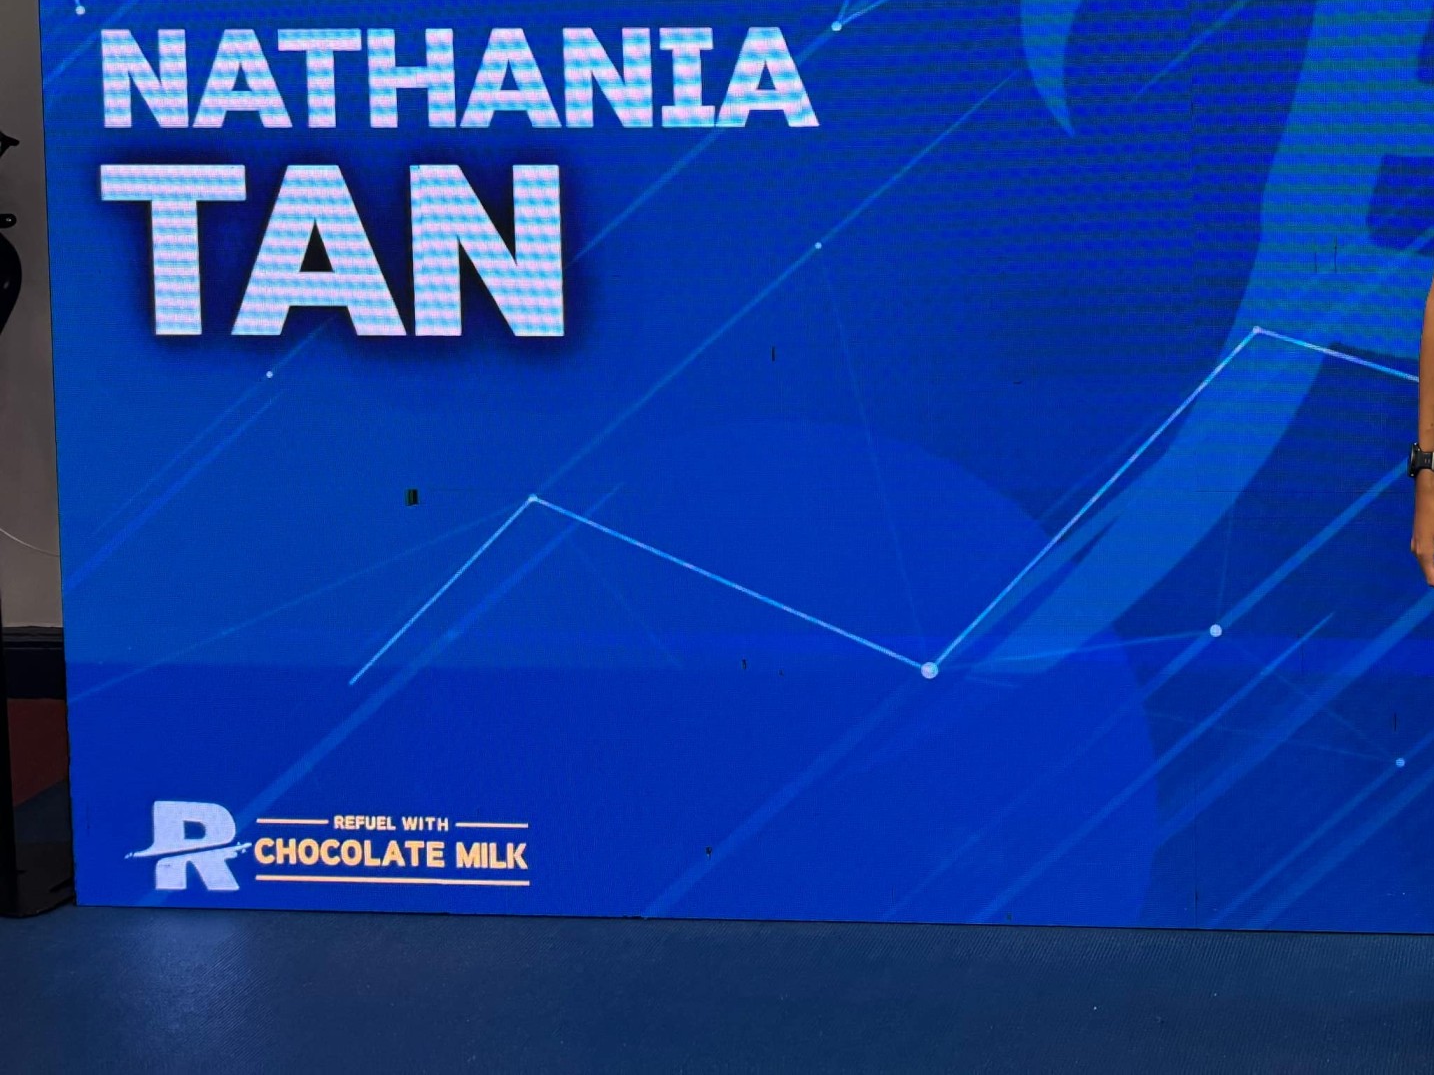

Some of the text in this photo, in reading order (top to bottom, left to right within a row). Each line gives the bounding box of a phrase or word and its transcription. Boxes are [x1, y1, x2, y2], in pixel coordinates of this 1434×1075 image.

[100, 26, 819, 128] NATHANIA
[100, 164, 565, 337] TAN
[253, 837, 529, 871] CHOCOLATE MILK
[333, 814, 449, 832] REFUEL WITH
